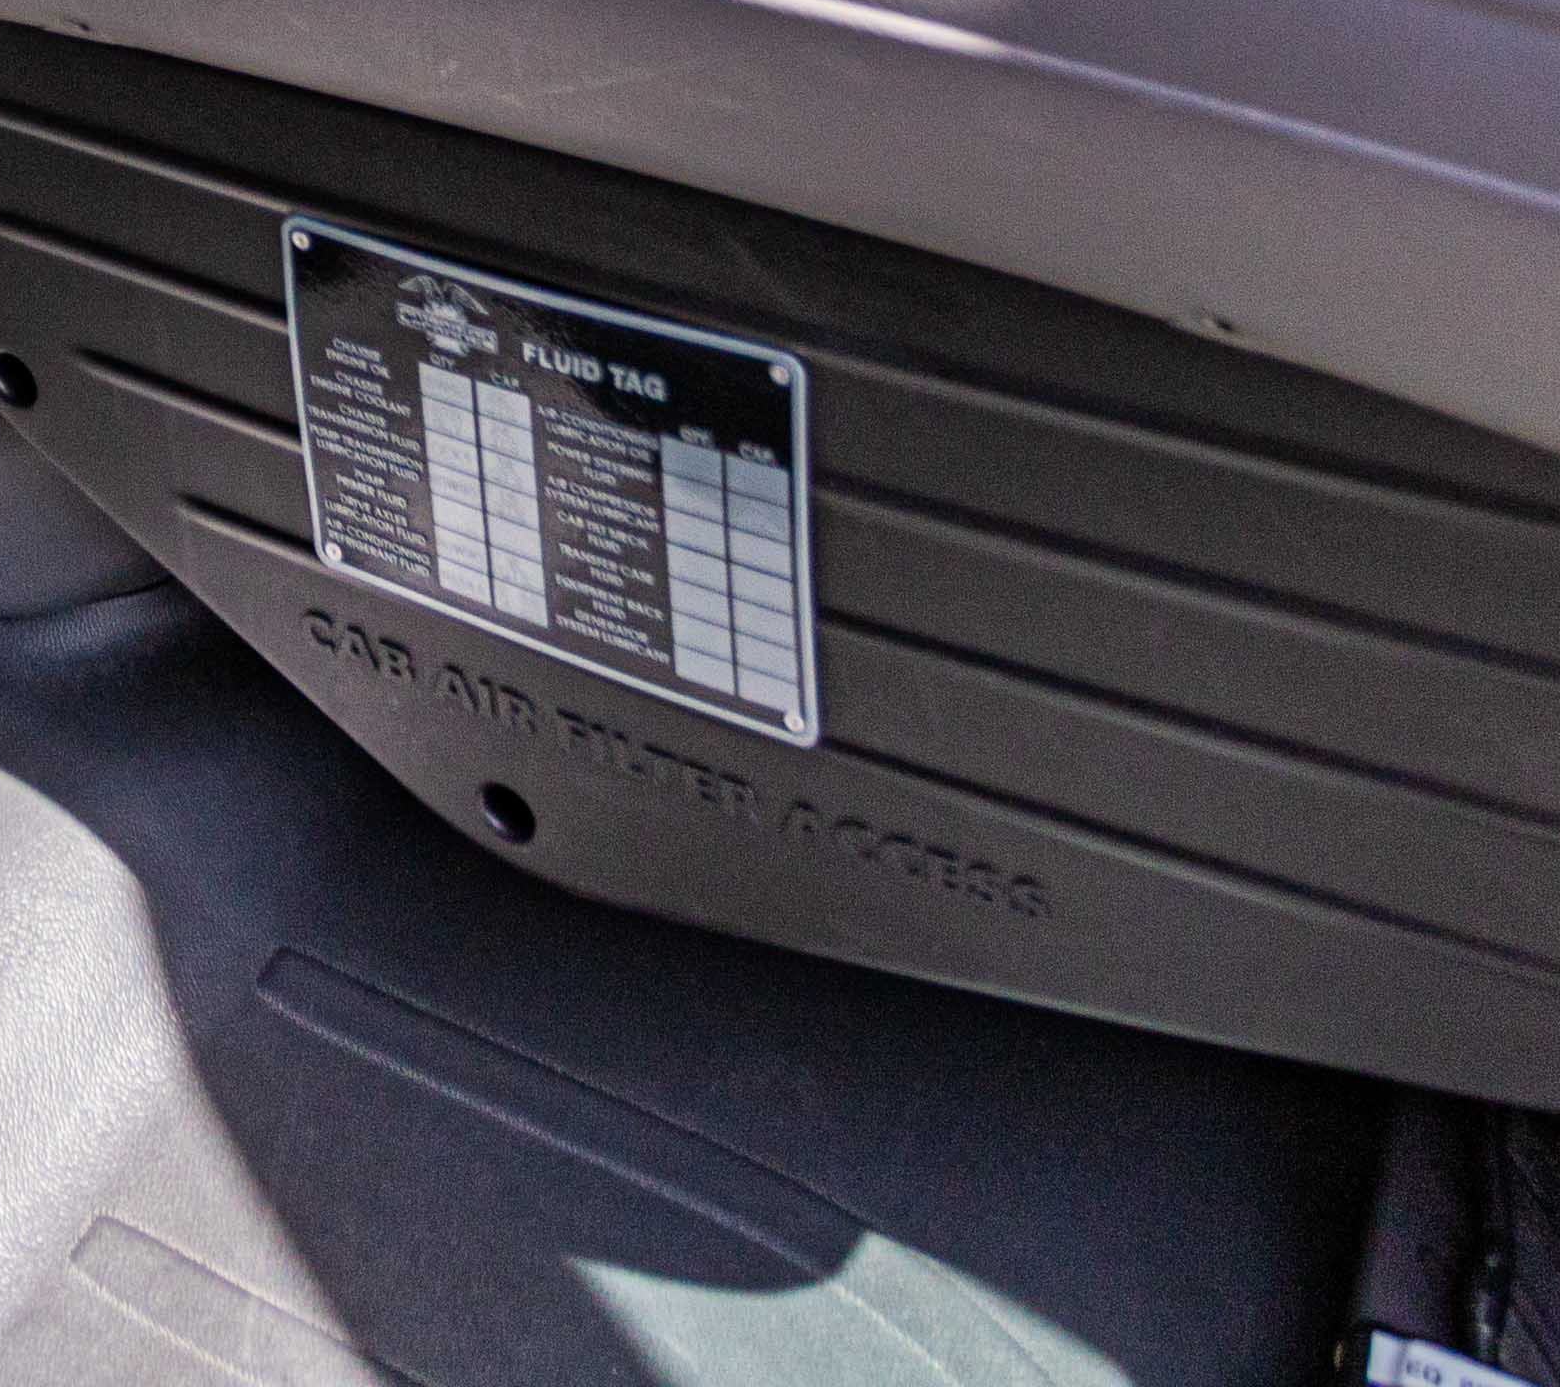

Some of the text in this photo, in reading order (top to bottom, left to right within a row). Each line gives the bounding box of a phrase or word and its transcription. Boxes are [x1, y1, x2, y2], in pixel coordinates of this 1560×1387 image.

[522, 342, 667, 402] FLUID TAG
[305, 607, 1054, 920] CAB AIR FILTER ACCESS
